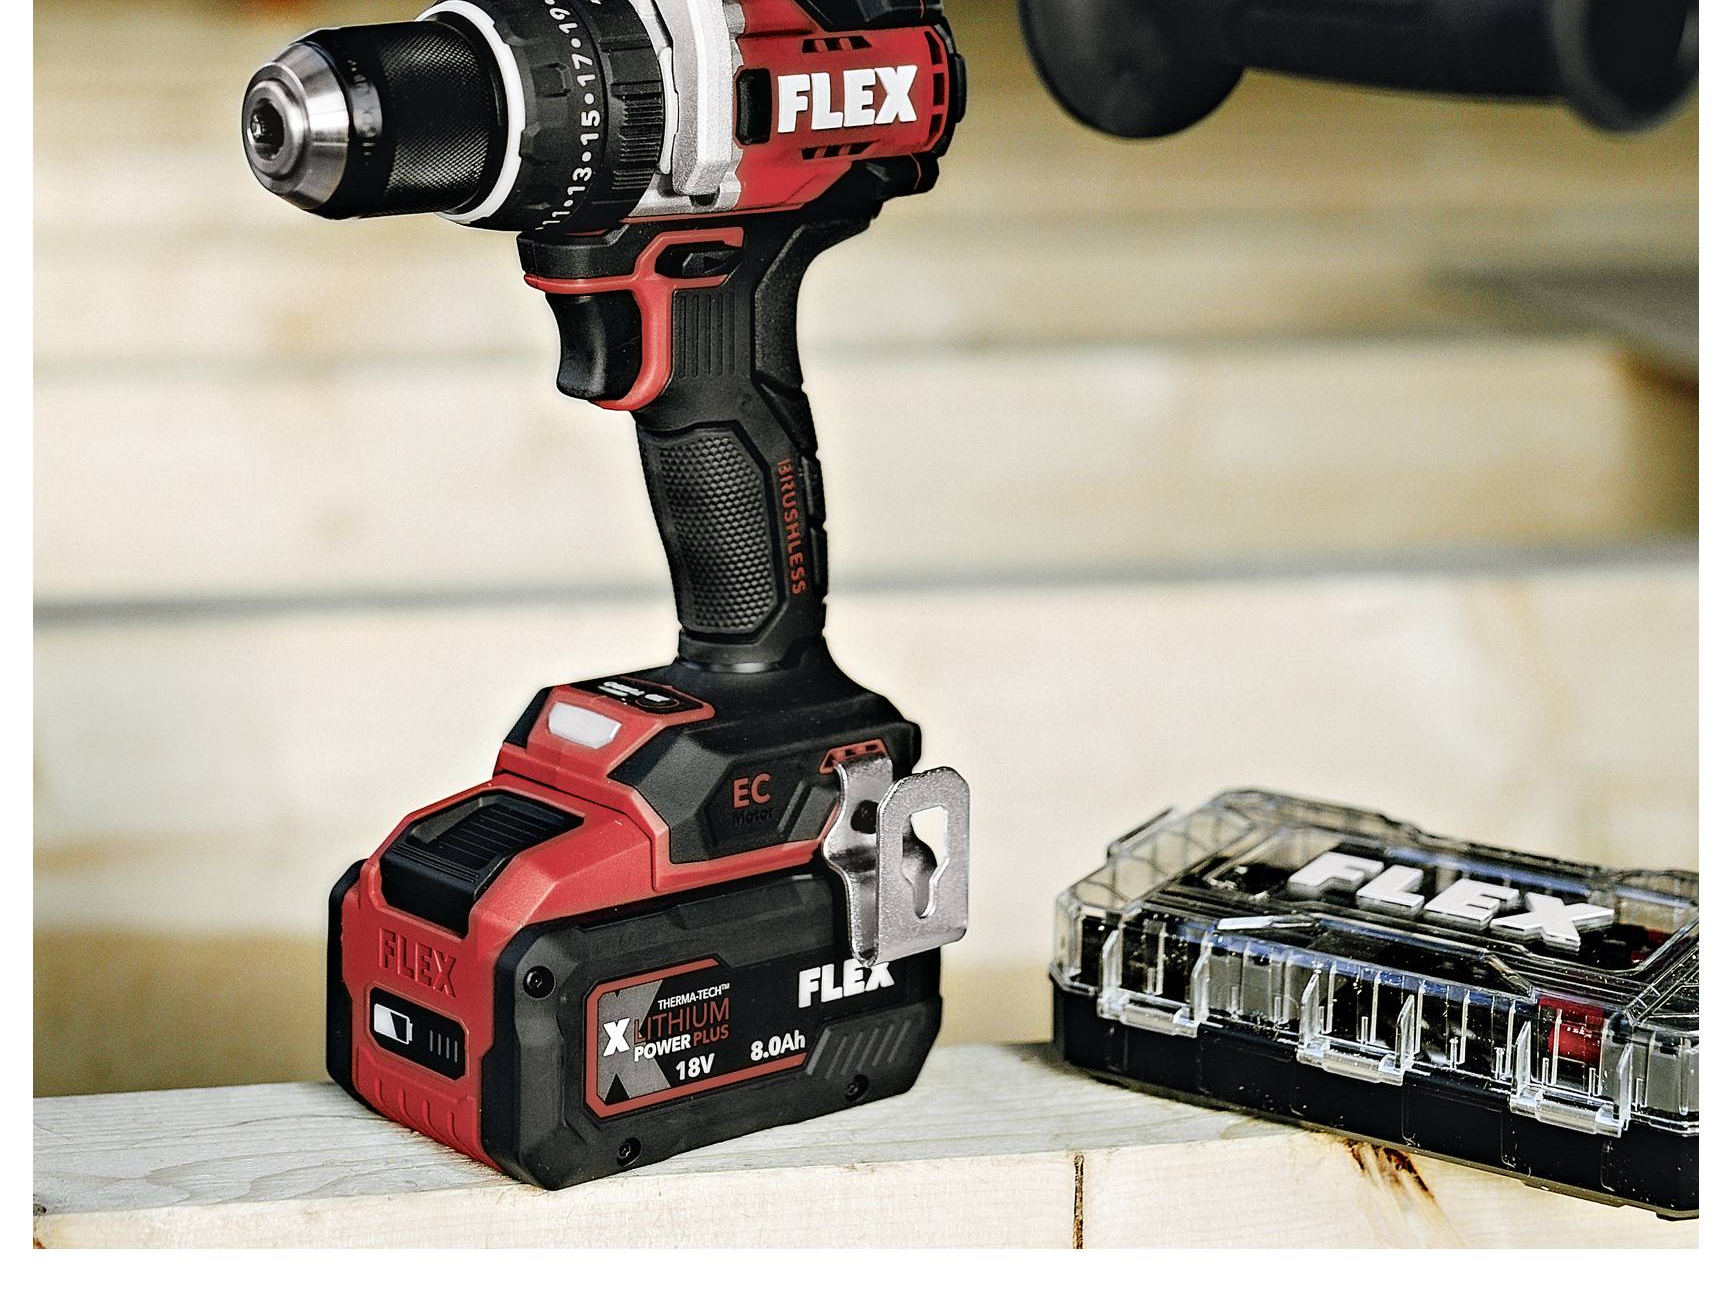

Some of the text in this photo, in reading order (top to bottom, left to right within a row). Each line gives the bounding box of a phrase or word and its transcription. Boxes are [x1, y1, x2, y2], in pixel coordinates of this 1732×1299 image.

[549, 7, 579, 34] 19
[571, 53, 597, 88] 17
[777, 64, 918, 134] FLEX
[580, 109, 600, 146] 15
[567, 167, 593, 196] 13
[777, 458, 808, 595] BRUSHLESS
[733, 773, 772, 809] EC
[1287, 851, 1615, 953] FLEX
[378, 927, 457, 998] FLEX
[798, 957, 896, 1009] FLEX
[634, 997, 730, 1046] LITHIUM
[634, 1023, 729, 1062] POWER PLUS
[750, 1029, 807, 1061] 8.0Ah
[675, 1052, 716, 1080] 18V
